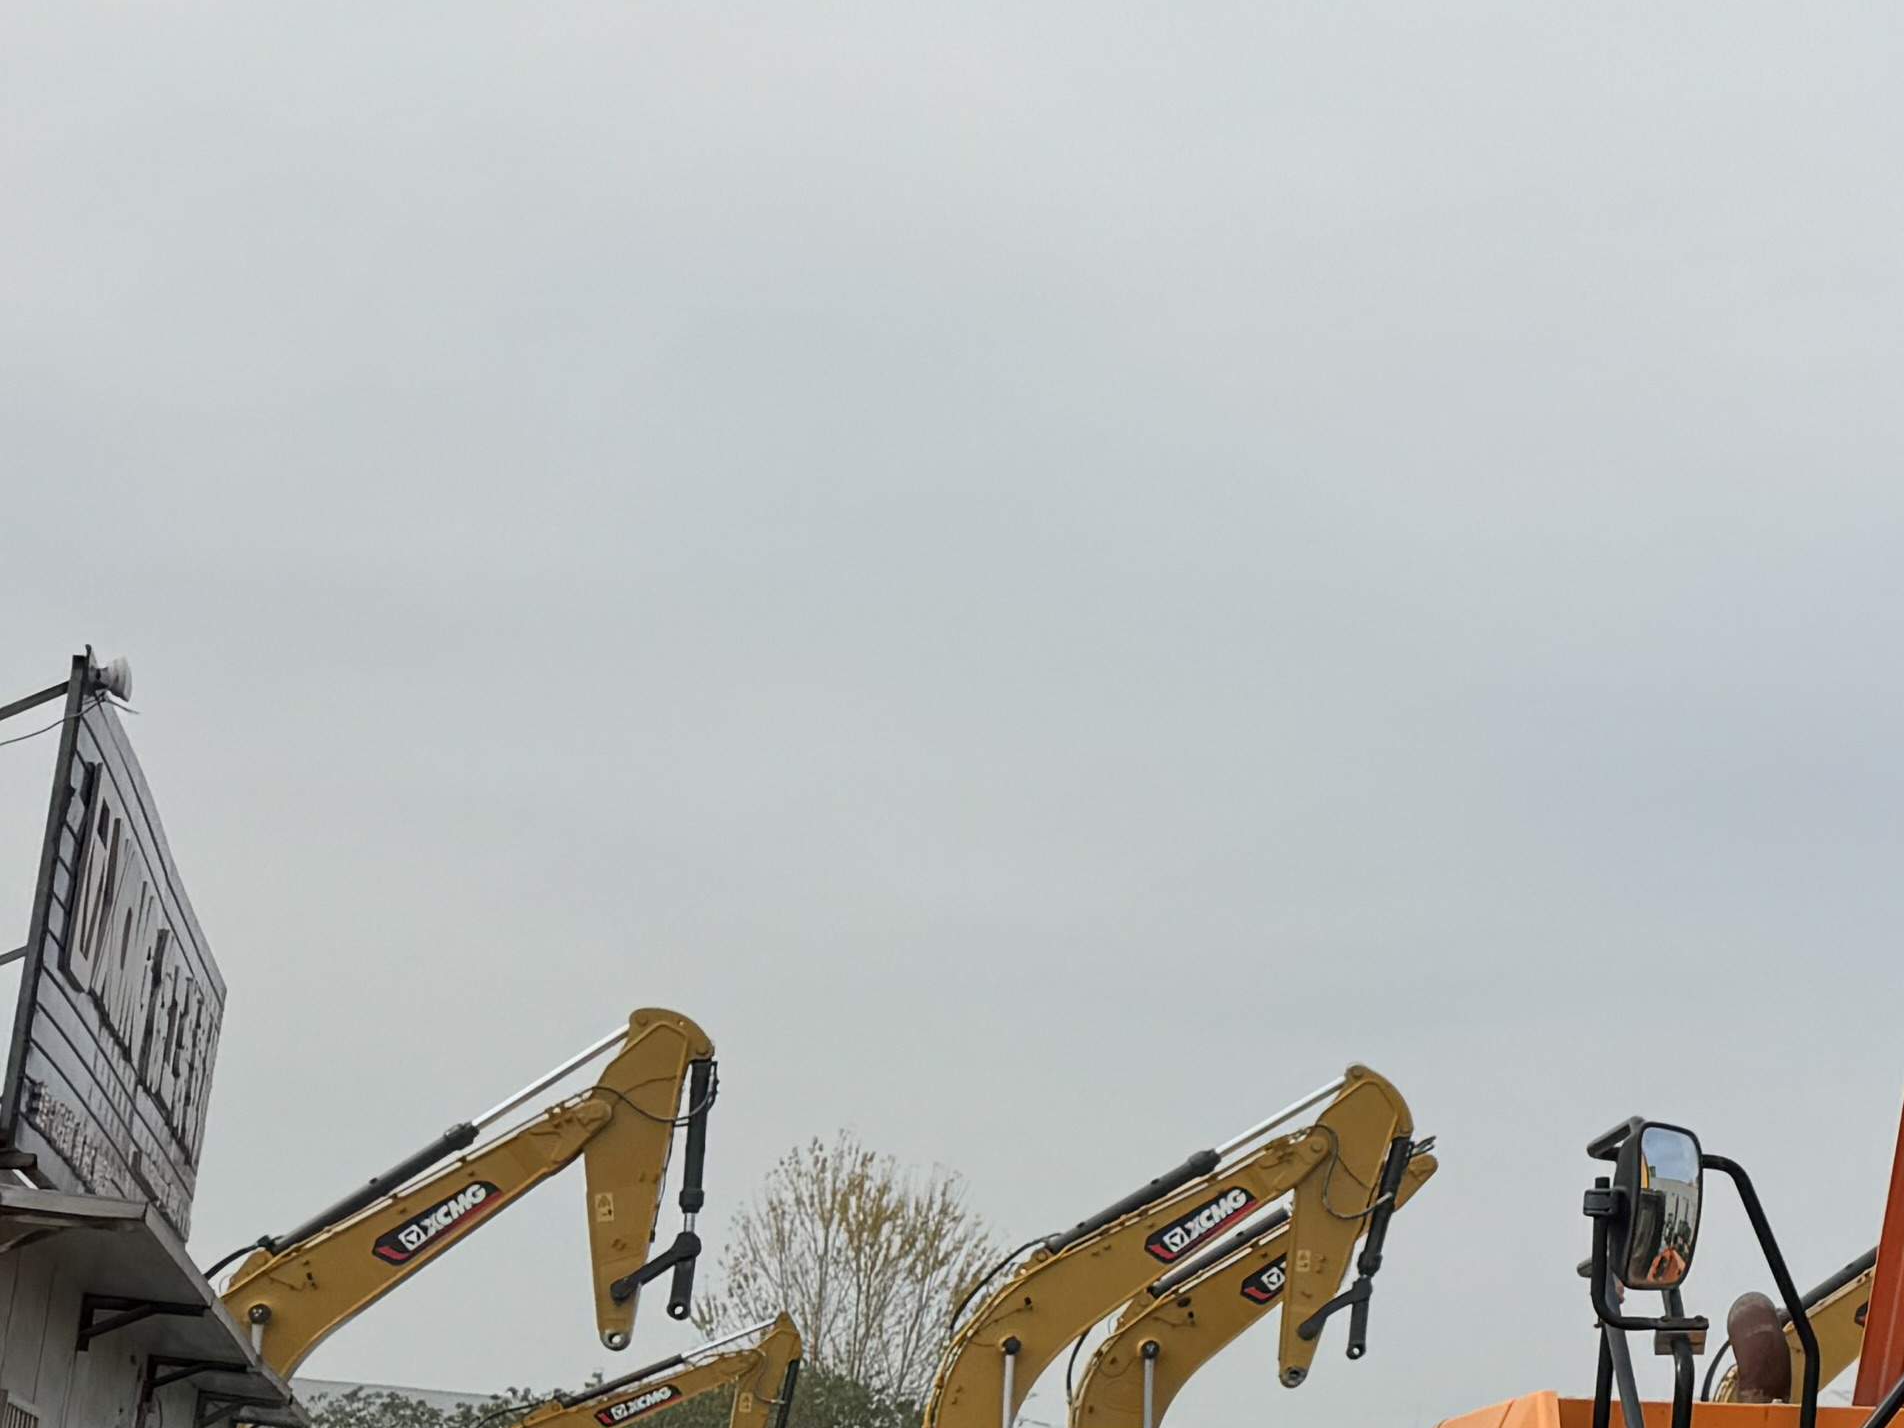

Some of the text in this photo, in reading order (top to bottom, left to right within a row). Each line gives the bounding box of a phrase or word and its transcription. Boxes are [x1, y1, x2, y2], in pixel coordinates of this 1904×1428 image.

[419, 1184, 486, 1236] XCMG
[1184, 1189, 1247, 1238] XCMG
[627, 1386, 672, 1414] XCMG
